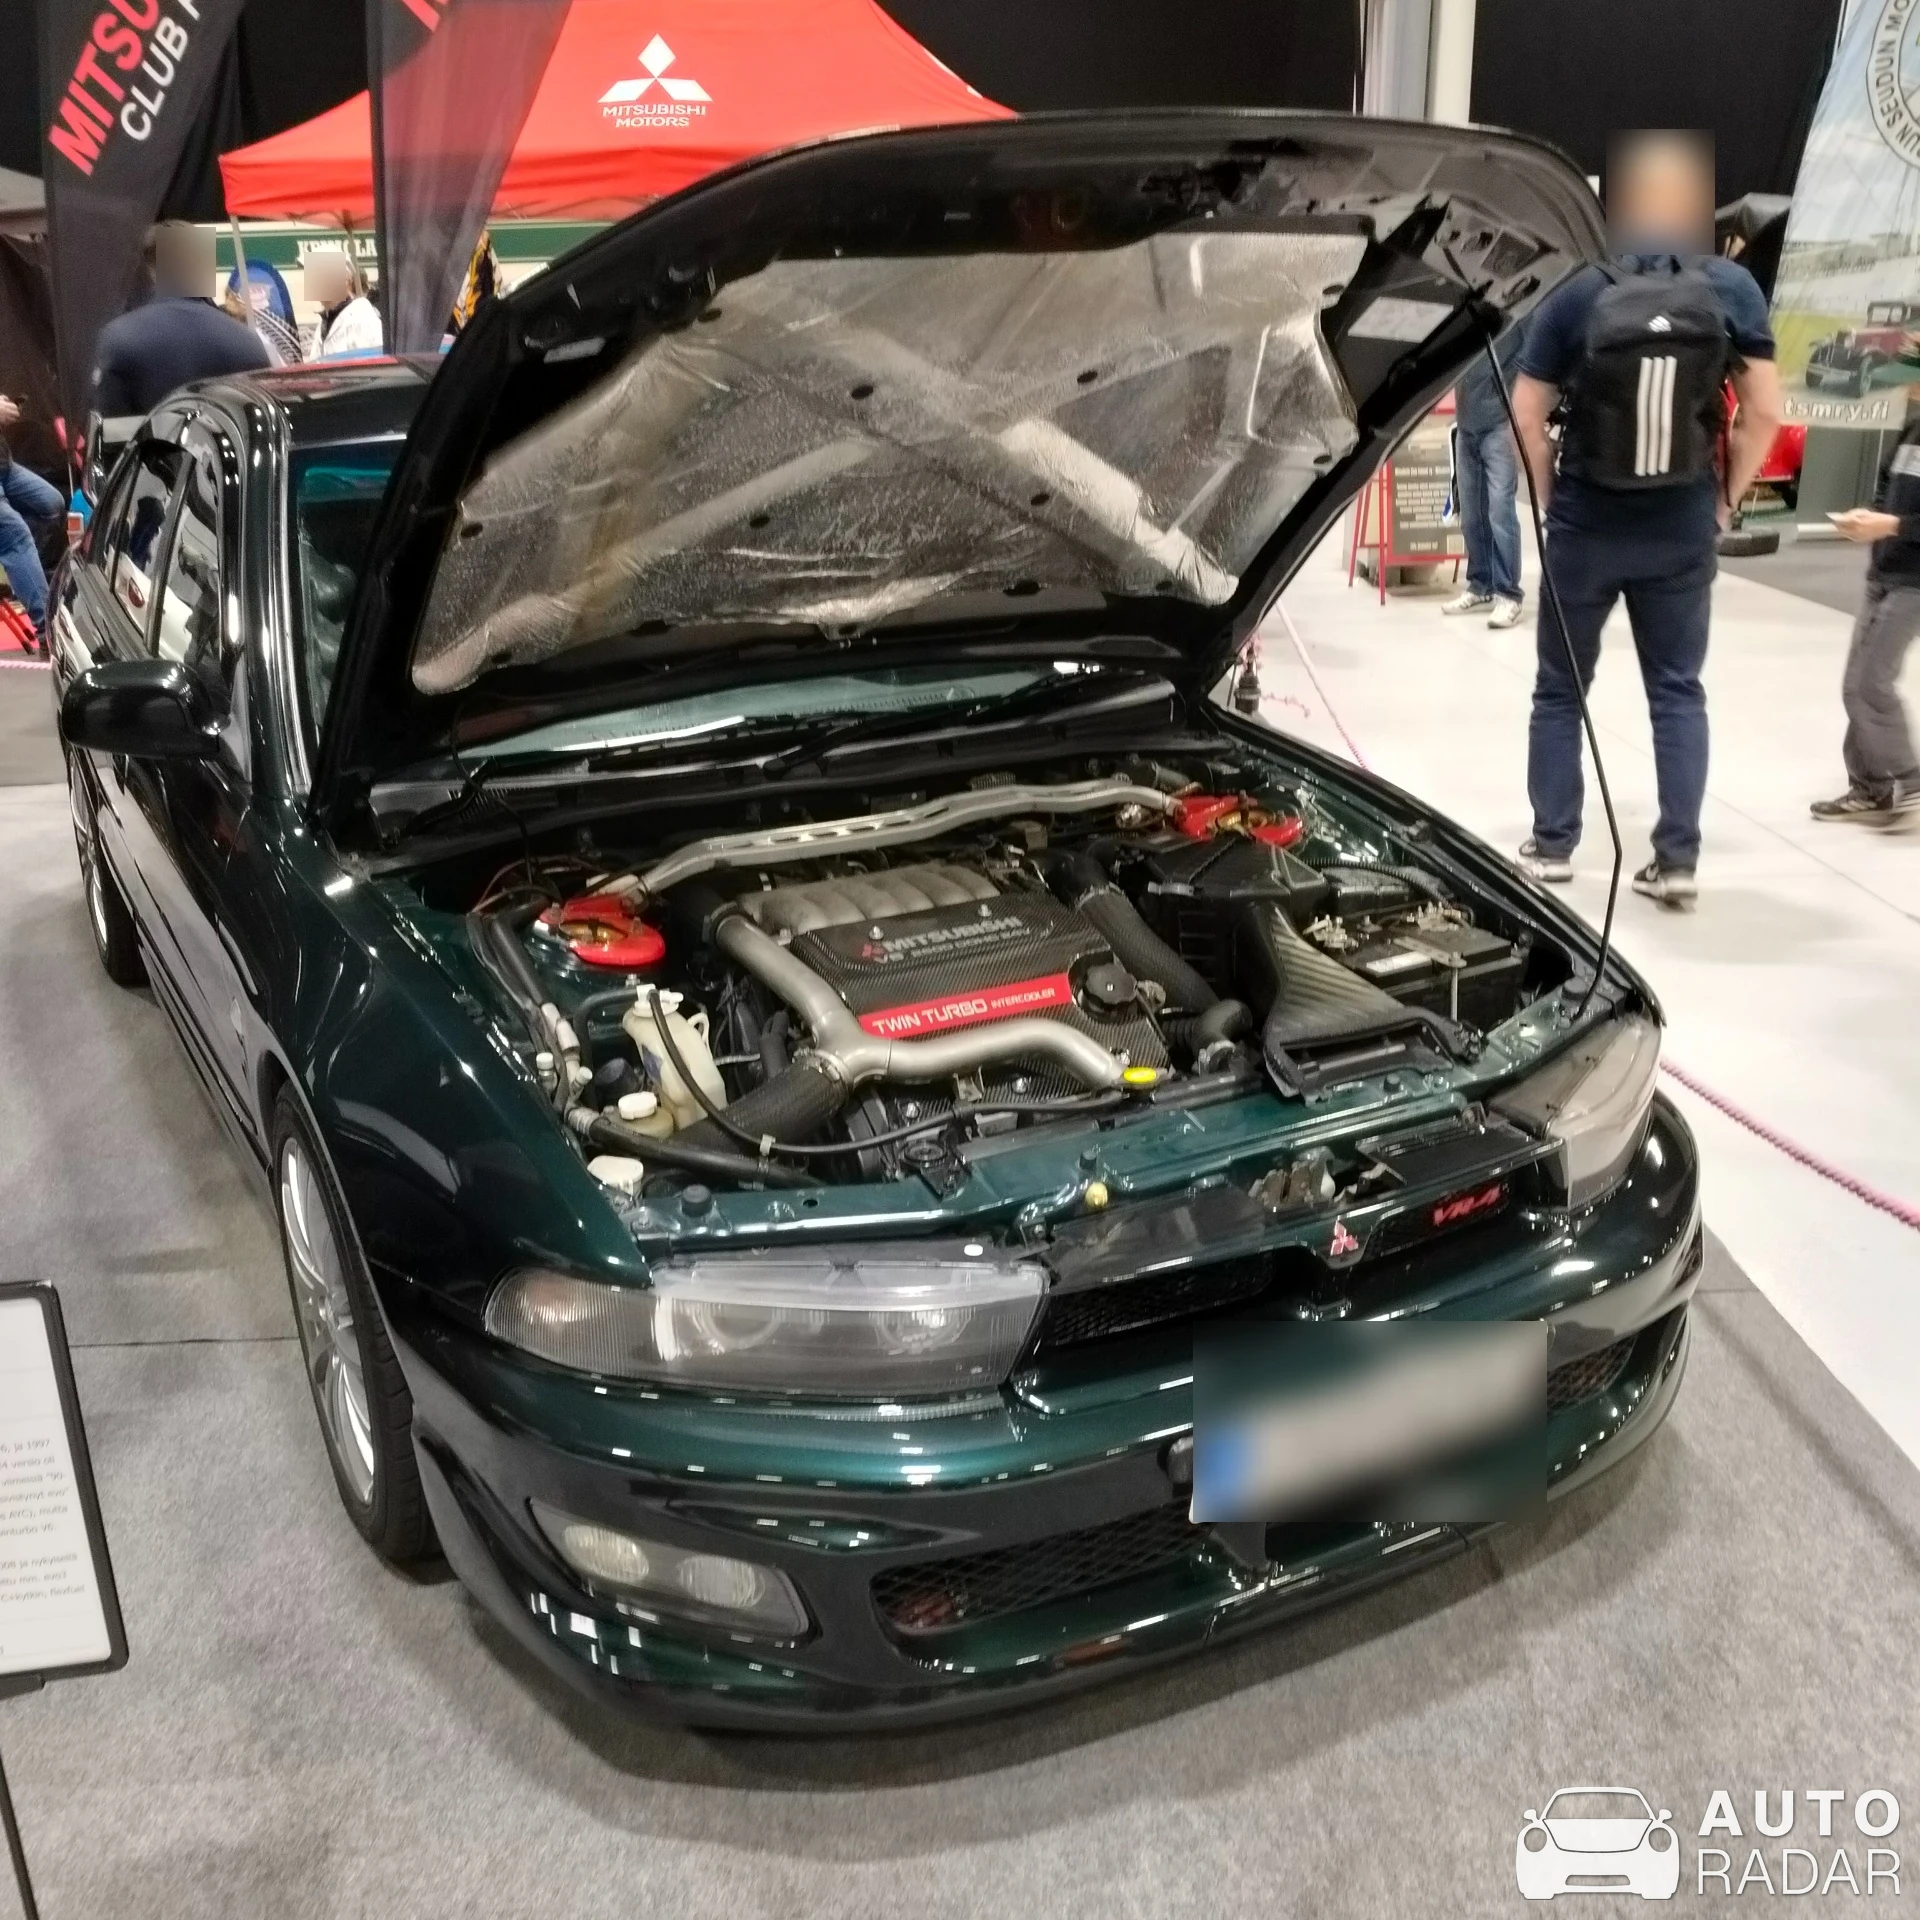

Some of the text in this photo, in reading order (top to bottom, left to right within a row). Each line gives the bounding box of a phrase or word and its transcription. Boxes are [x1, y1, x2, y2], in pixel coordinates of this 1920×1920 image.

[120, 16, 188, 141] CLUB
[602, 103, 707, 117] MITSUBISHI
[615, 116, 690, 128] MOTORS
[1783, 396, 1890, 423] tsmry.fi
[871, 987, 1056, 1035] TWIN TURBO INTERCOOLER
